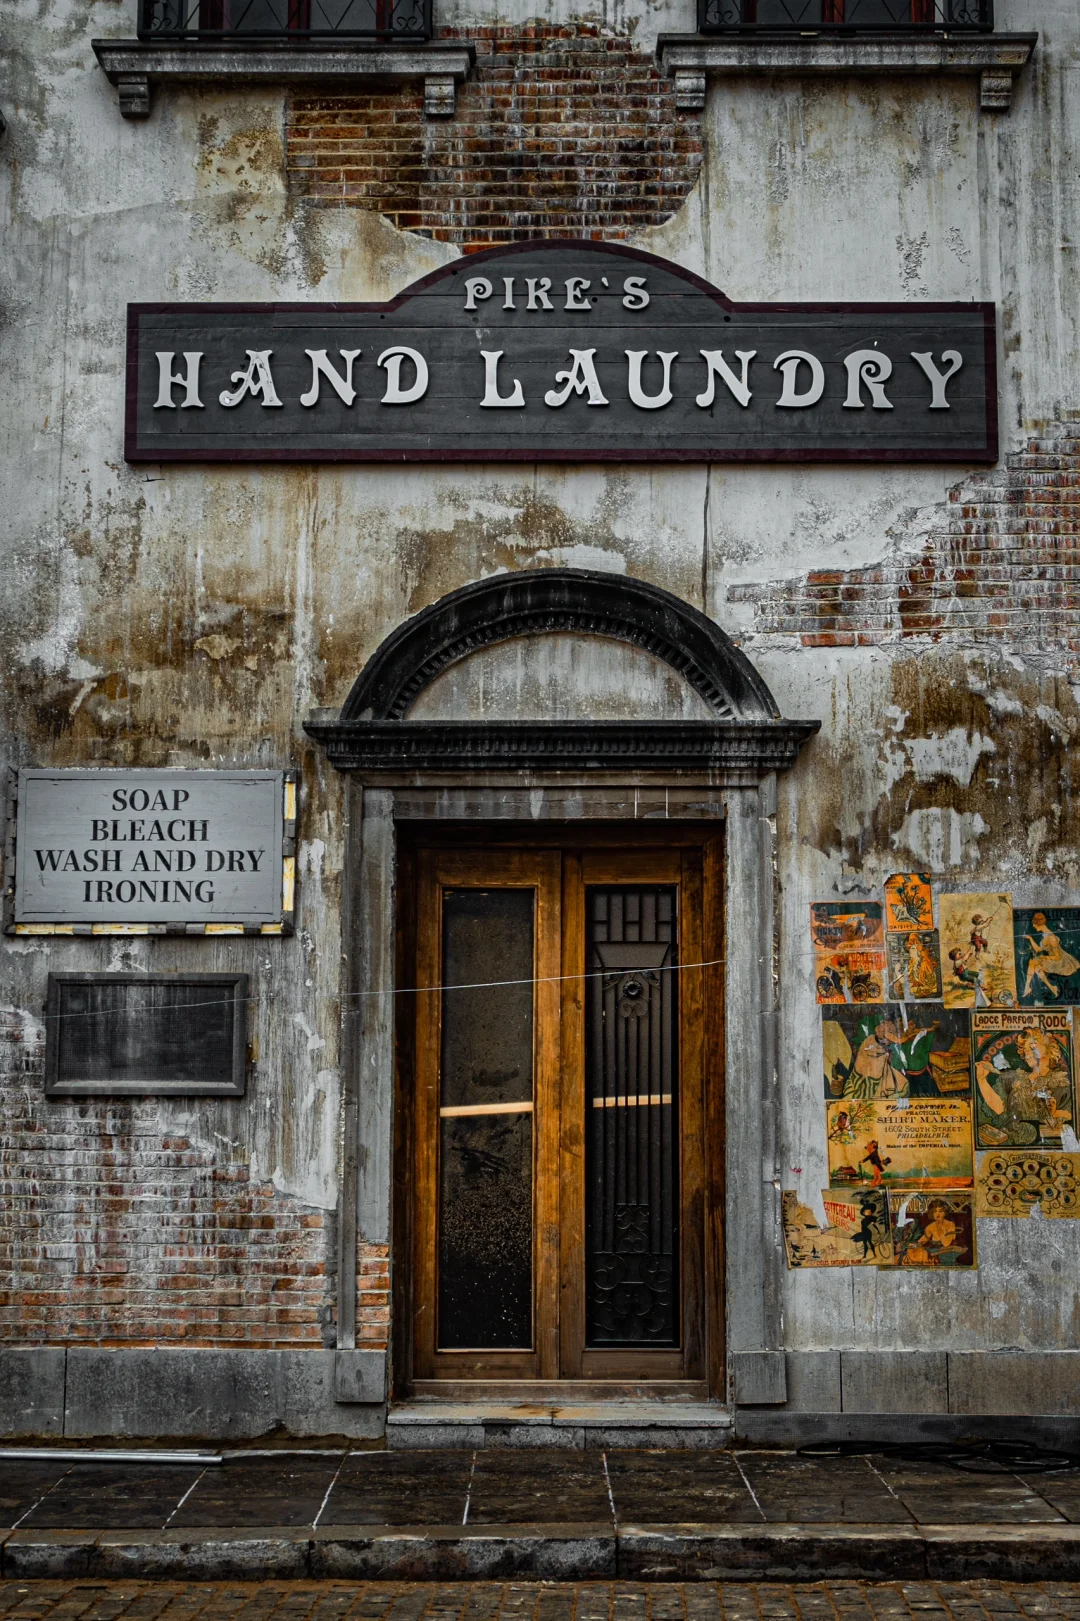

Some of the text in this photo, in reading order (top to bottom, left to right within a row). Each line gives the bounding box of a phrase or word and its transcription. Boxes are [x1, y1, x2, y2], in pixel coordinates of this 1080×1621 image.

[464, 276, 650, 311] PIKE'S
[153, 345, 963, 409] HAND LAUNDRY
[112, 788, 190, 812] SOAP
[90, 819, 209, 842] BLEACH
[34, 849, 266, 873] WASH AND DRY
[83, 880, 216, 903] IRONING
[877, 1116, 916, 1124] SHIRT
[884, 1125, 903, 1133] 1602
[905, 1125, 930, 1133] SOUTH
